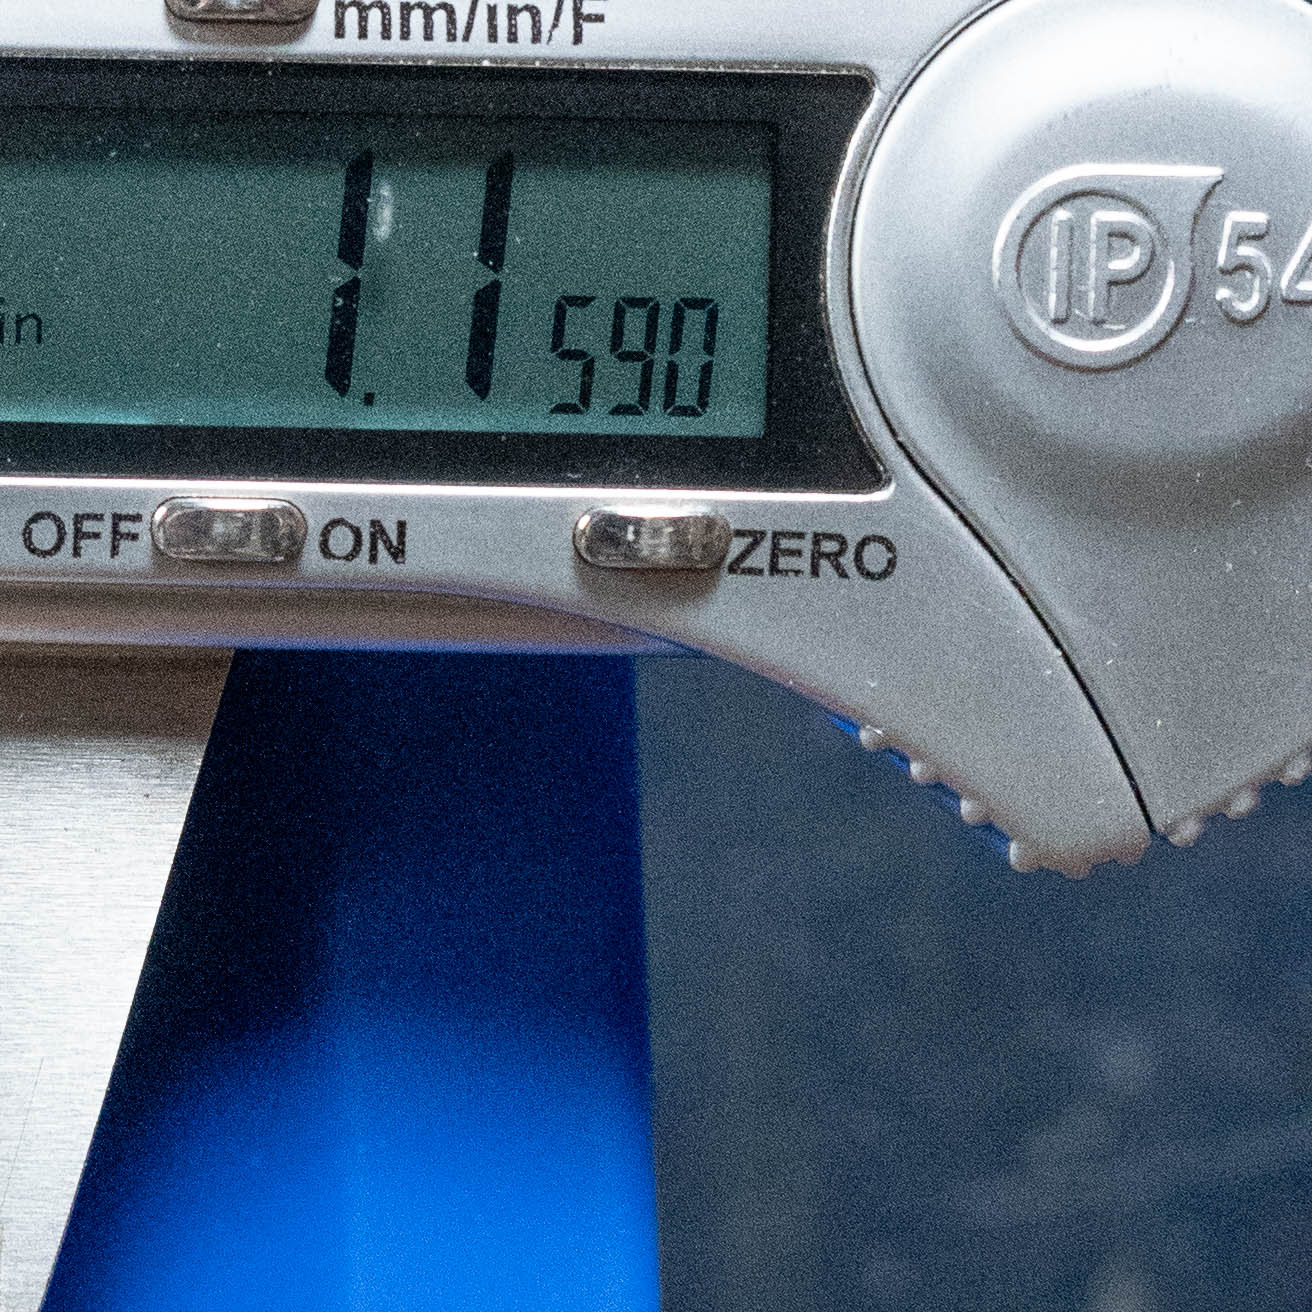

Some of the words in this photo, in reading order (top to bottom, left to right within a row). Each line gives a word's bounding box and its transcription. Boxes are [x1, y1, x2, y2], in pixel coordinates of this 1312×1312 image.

[1048, 207, 1155, 328] IP
[21, 511, 143, 560] OFF
[319, 517, 408, 565] ON
[726, 528, 899, 581] ZERO
